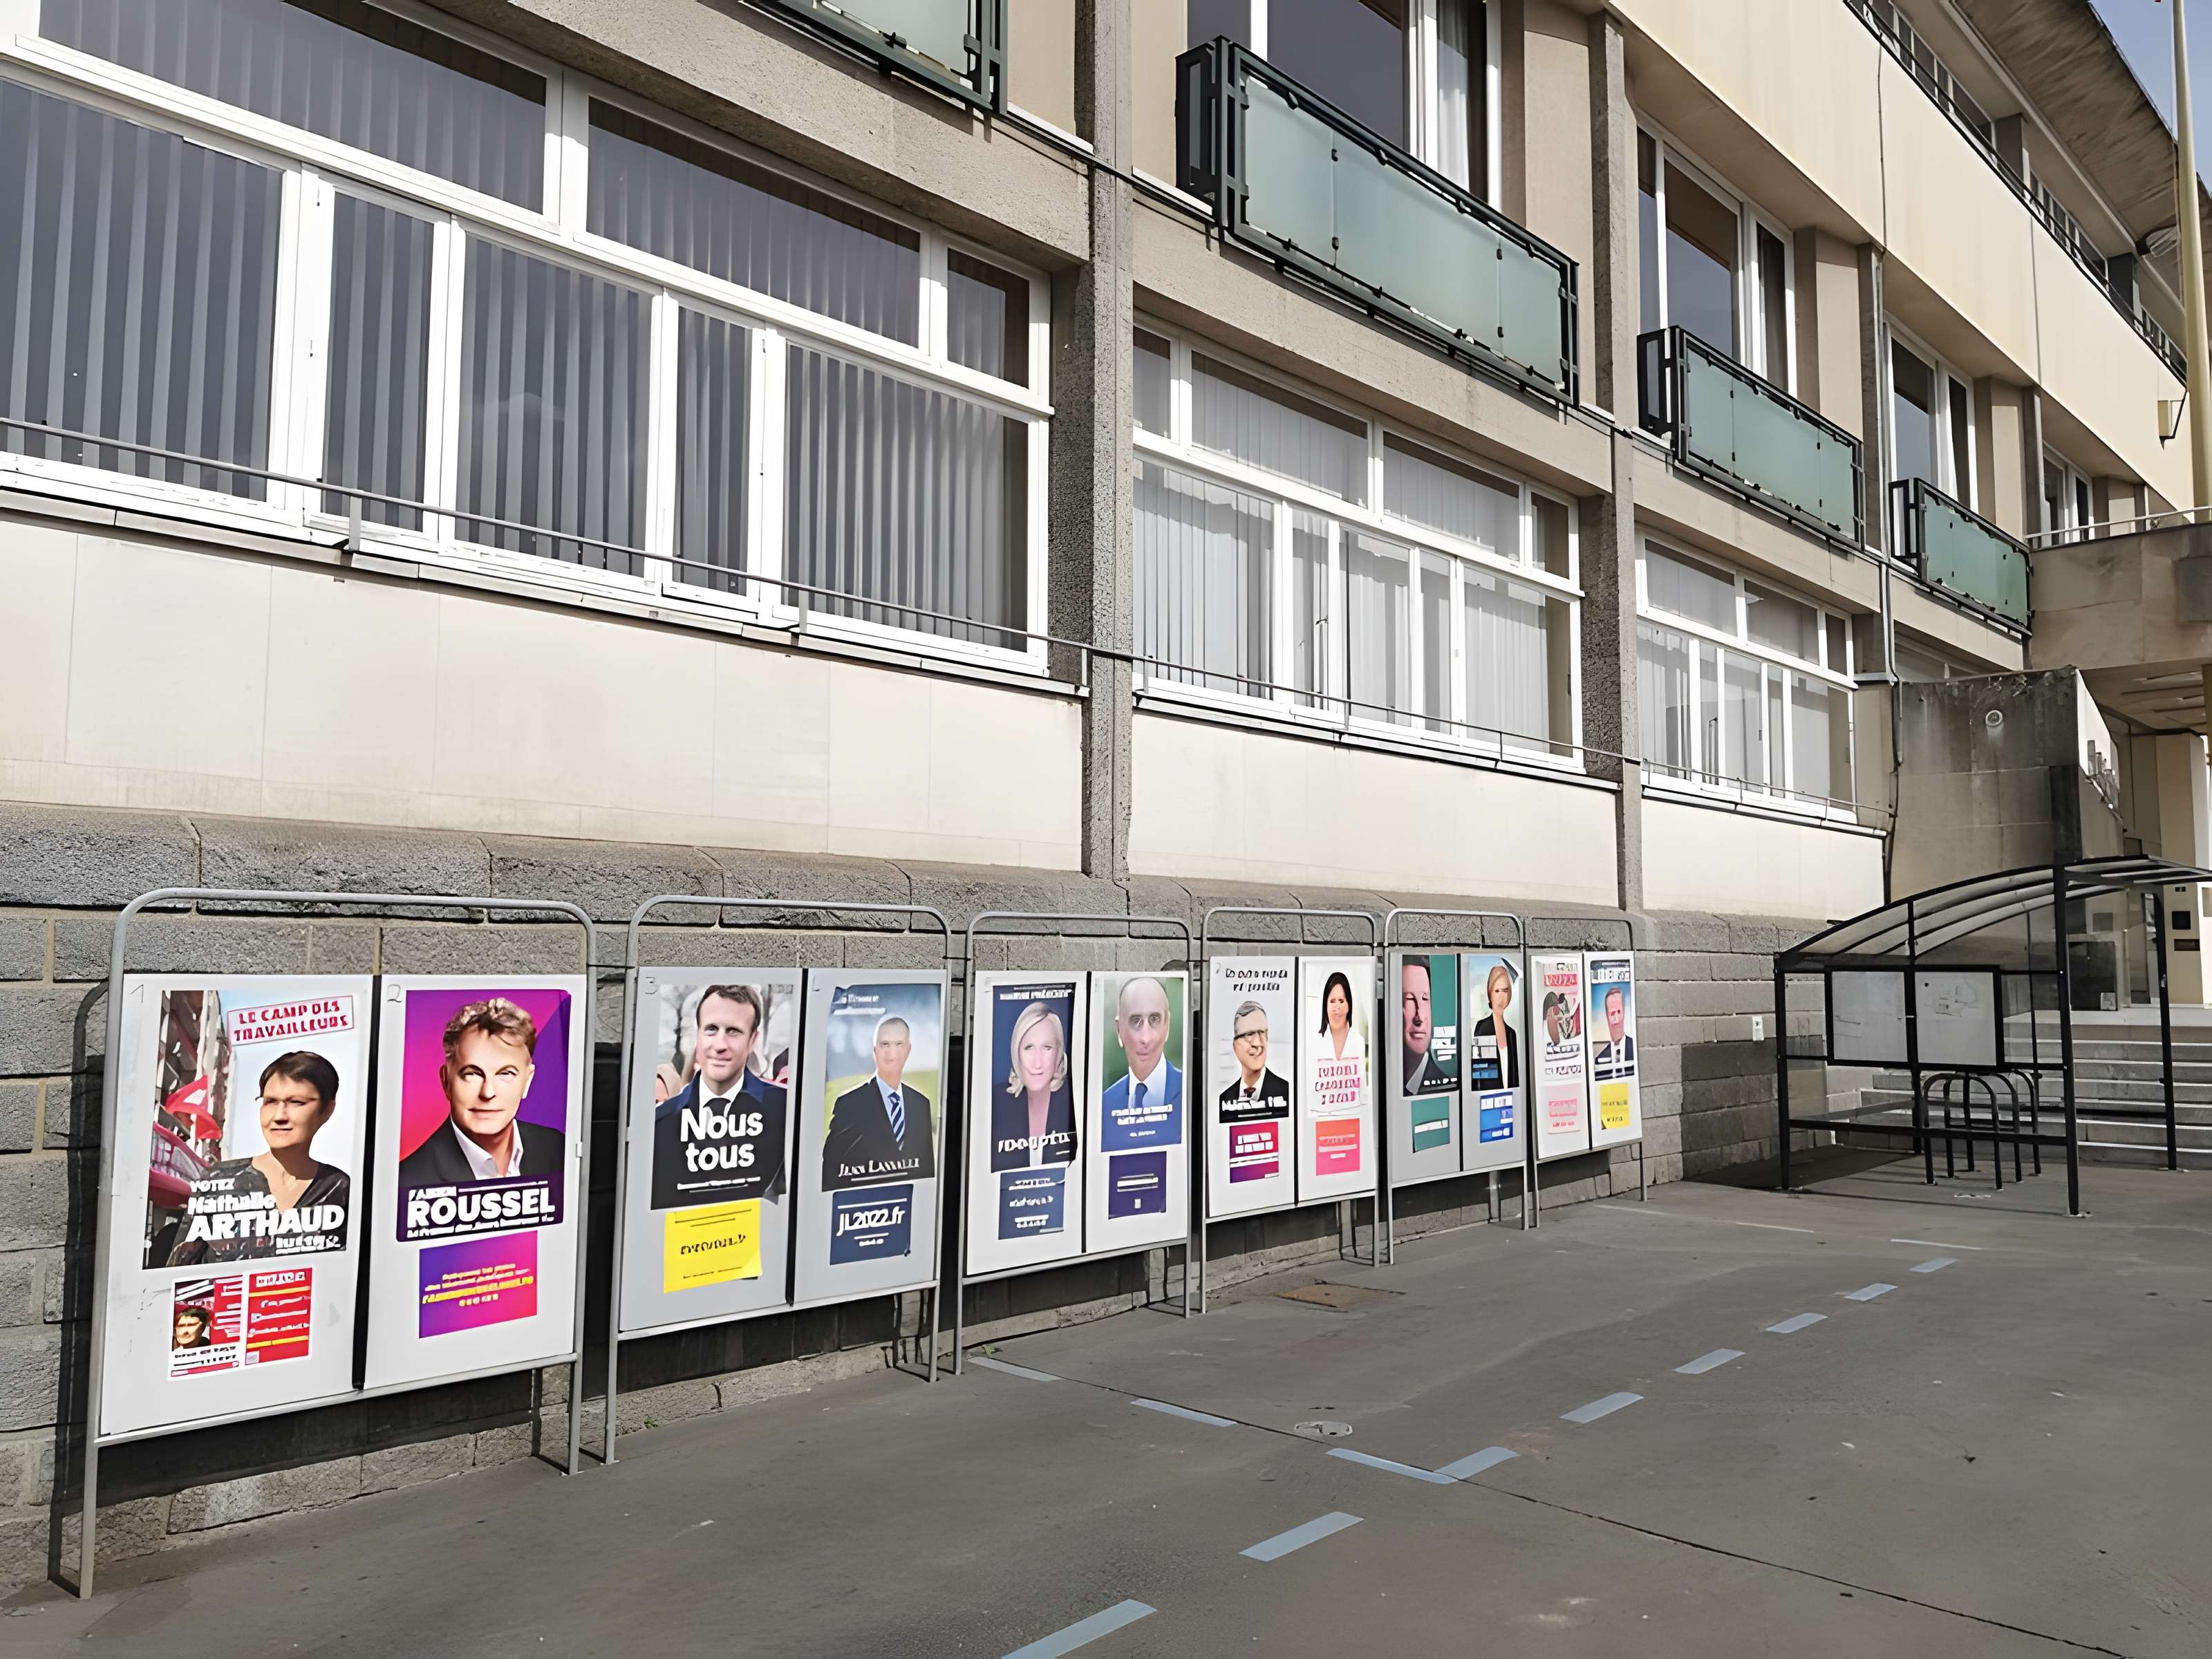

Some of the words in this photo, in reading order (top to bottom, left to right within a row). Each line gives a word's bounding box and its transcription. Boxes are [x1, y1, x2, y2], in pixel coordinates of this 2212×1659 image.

[680, 1108, 763, 1142] Nous
[686, 1143, 755, 1172] tous
[185, 1204, 345, 1243] ARTHAUD
[407, 1187, 555, 1228] ROUSSEL
